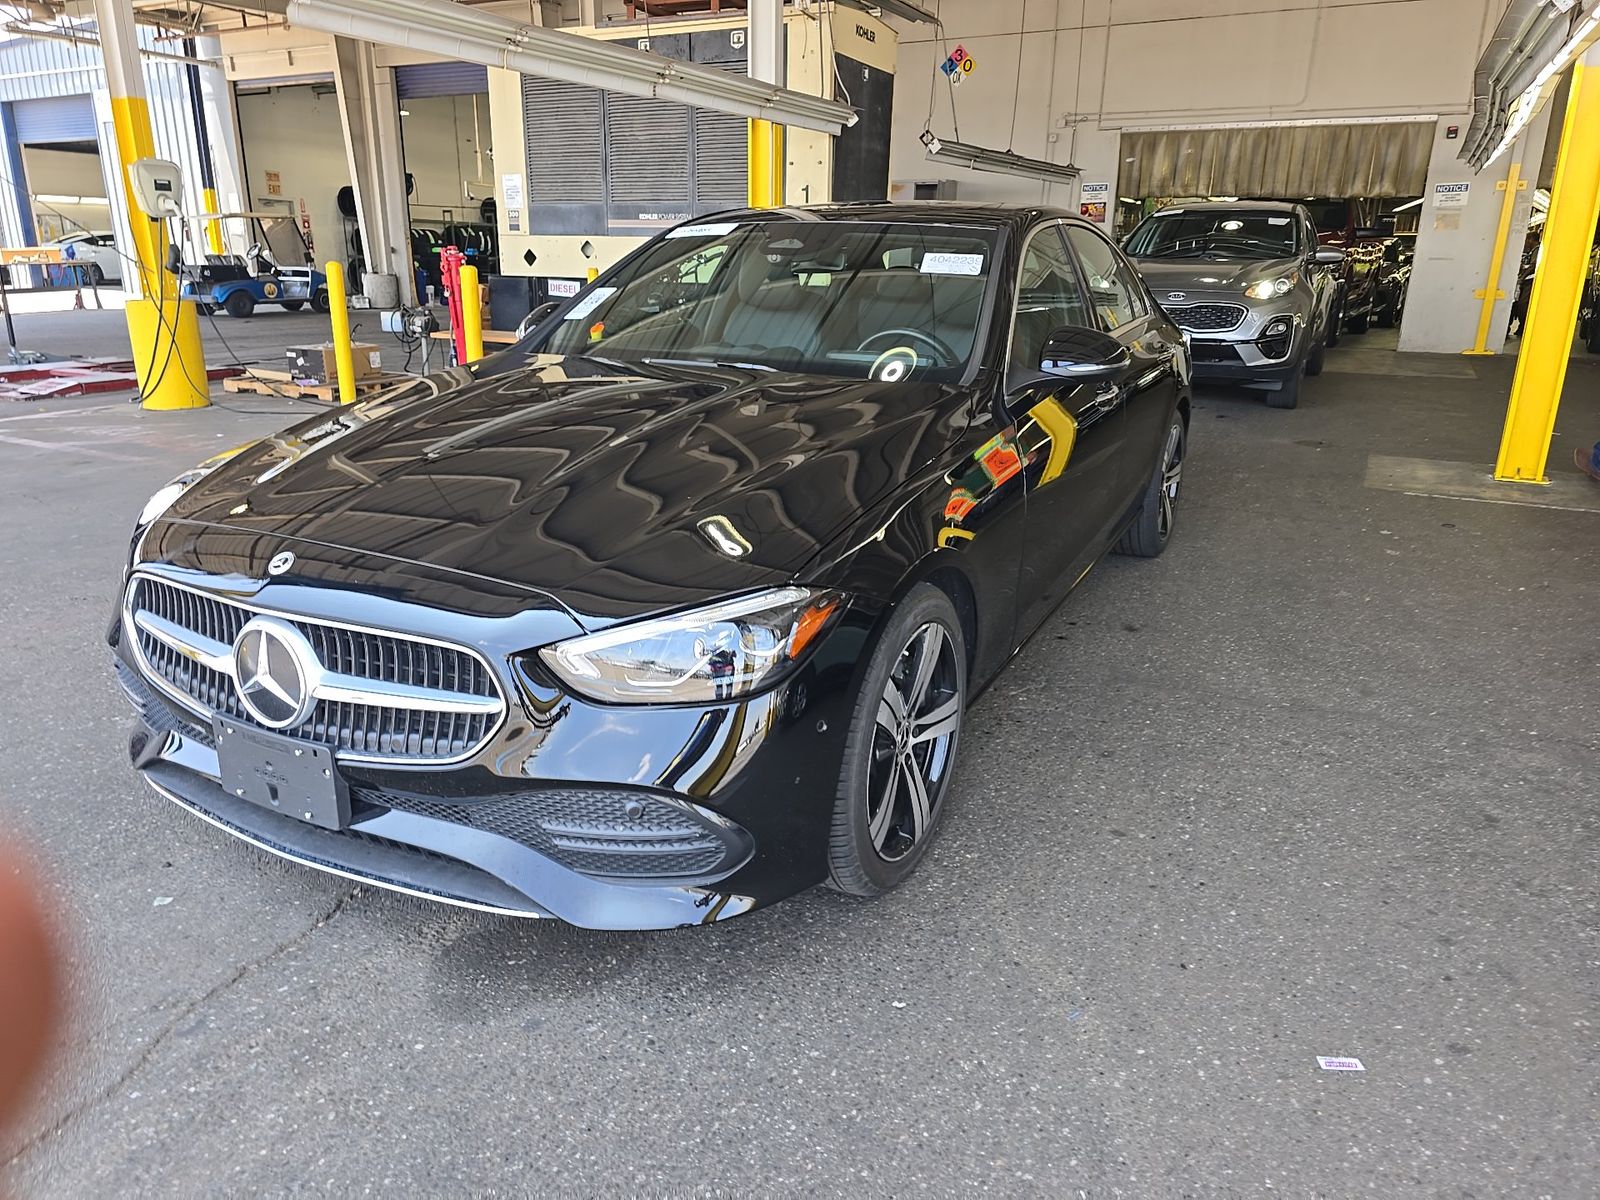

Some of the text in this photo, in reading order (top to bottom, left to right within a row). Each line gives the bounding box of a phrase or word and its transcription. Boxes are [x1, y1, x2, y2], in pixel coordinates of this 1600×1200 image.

[856, 24, 876, 44] KOHLER
[954, 48, 963, 62] 3
[945, 58, 954, 72] 2
[963, 58, 972, 72] 0
[801, 184, 809, 204] 1
[1437, 184, 1468, 193] NOTICE
[550, 283, 577, 294] DIESEL
